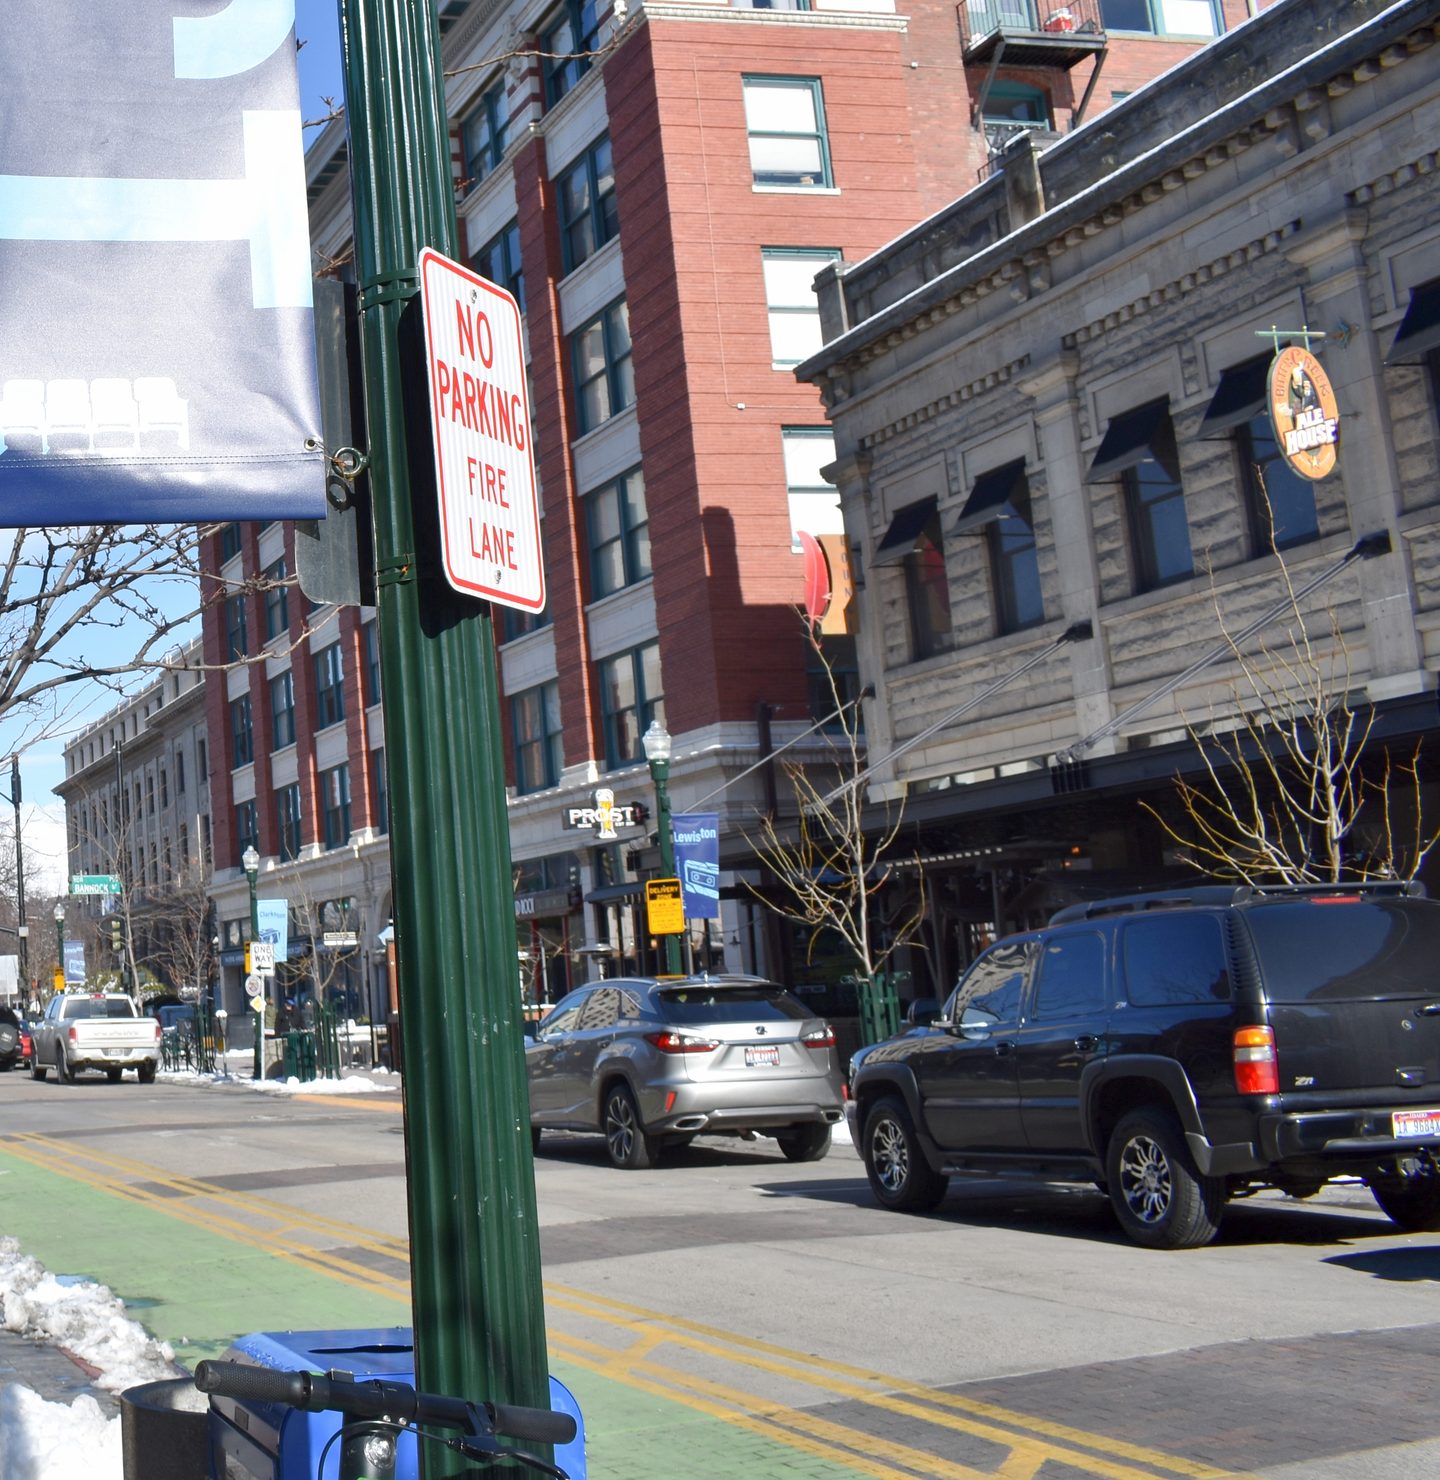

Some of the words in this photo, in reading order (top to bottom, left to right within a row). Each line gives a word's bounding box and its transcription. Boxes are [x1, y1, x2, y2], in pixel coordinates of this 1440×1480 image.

[455, 299, 494, 369] NO
[436, 359, 525, 452] PARKING
[1296, 408, 1324, 429] ALE
[1284, 418, 1338, 456] HOUSE
[467, 456, 509, 509] FIRE
[468, 517, 518, 571] LANE
[569, 806, 634, 825] PROST
[673, 828, 717, 843] Lewiston
[650, 885, 679, 895] DELIVERY
[254, 946, 271, 955] ONE
[255, 954, 271, 962] WAY
